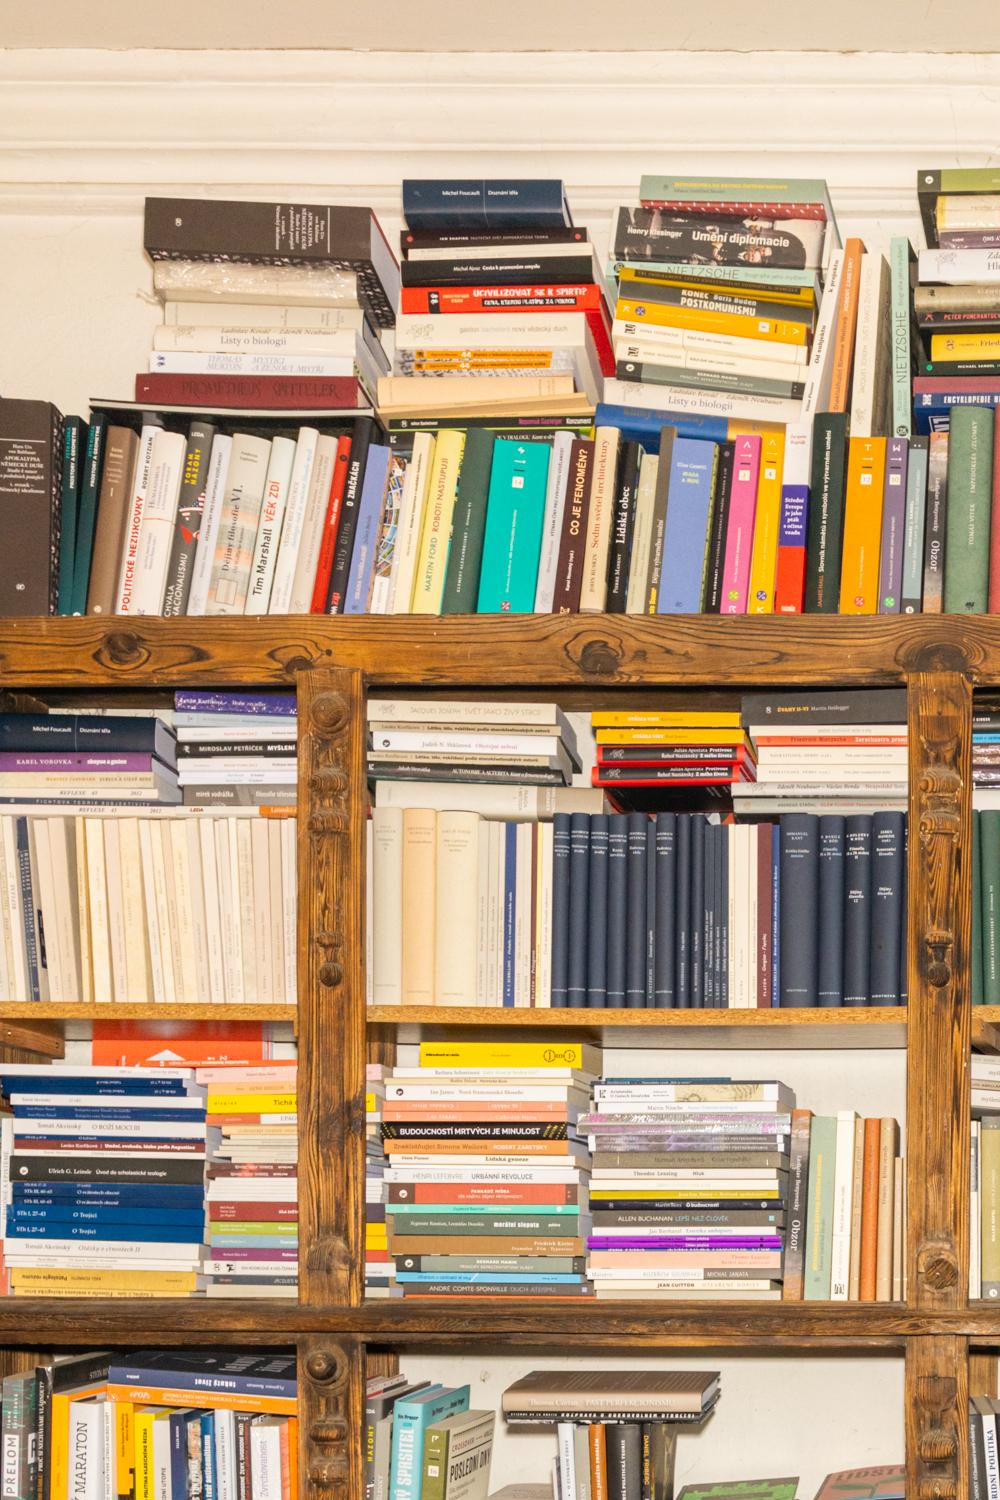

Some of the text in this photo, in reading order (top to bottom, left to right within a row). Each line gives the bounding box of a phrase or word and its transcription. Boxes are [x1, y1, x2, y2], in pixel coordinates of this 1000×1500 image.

[692, 230, 790, 249] Umění diplomacie
[680, 298, 756, 317] POSTKOMUNISMU
[681, 289, 709, 300] KONEC
[221, 336, 241, 347] Listy
[252, 336, 286, 347] biologii
[895, 311, 908, 383] NIETZSCHE
[569, 449, 588, 535] CO JE FENOMÉN?
[615, 486, 630, 544] Lidská obec
[121, 496, 143, 611] POLITICKÉ NEZISKOVKY
[252, 480, 279, 595] Tim Marshall VĚK ZDÍ
[400, 1127, 453, 1135] BUDOUCNOSTÍ
[454, 1126, 491, 1135] MRTVÝCH
[501, 1127, 541, 1135] MINULOST
[5, 1437, 16, 1494] PŘELOM
[74, 1422, 88, 1494] MARATON
[987, 1430, 996, 1470] POLITIKA
